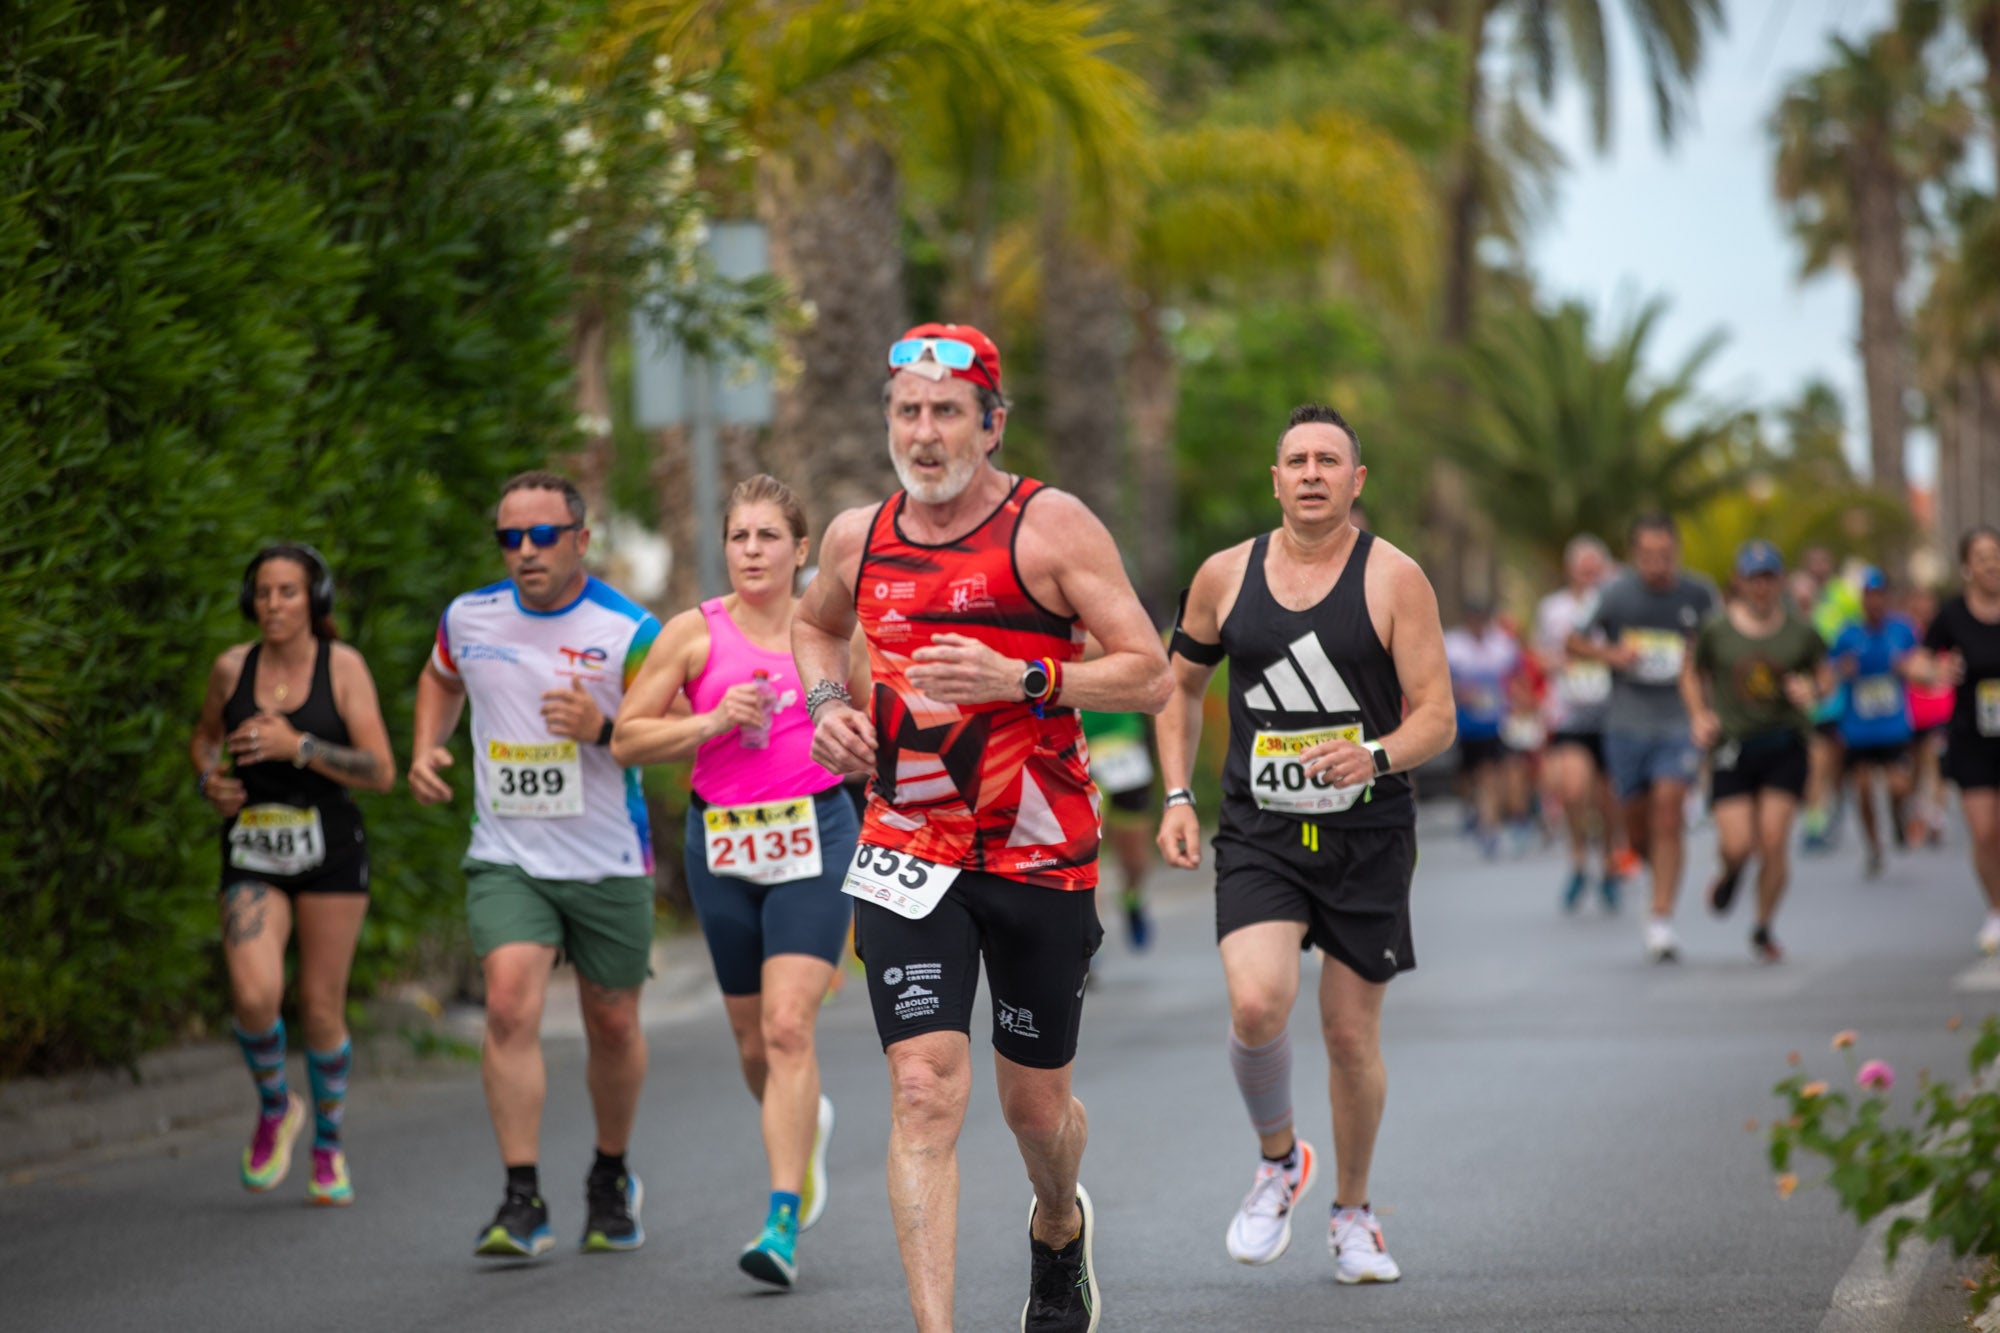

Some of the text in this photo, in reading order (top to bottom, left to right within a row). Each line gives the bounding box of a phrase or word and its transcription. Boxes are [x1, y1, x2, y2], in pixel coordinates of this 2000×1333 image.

[500, 767, 564, 796] 389
[711, 826, 813, 868] 2135
[895, 997, 939, 1011] ALBOLOTE
[901, 1009, 935, 1020] DEPORTES
